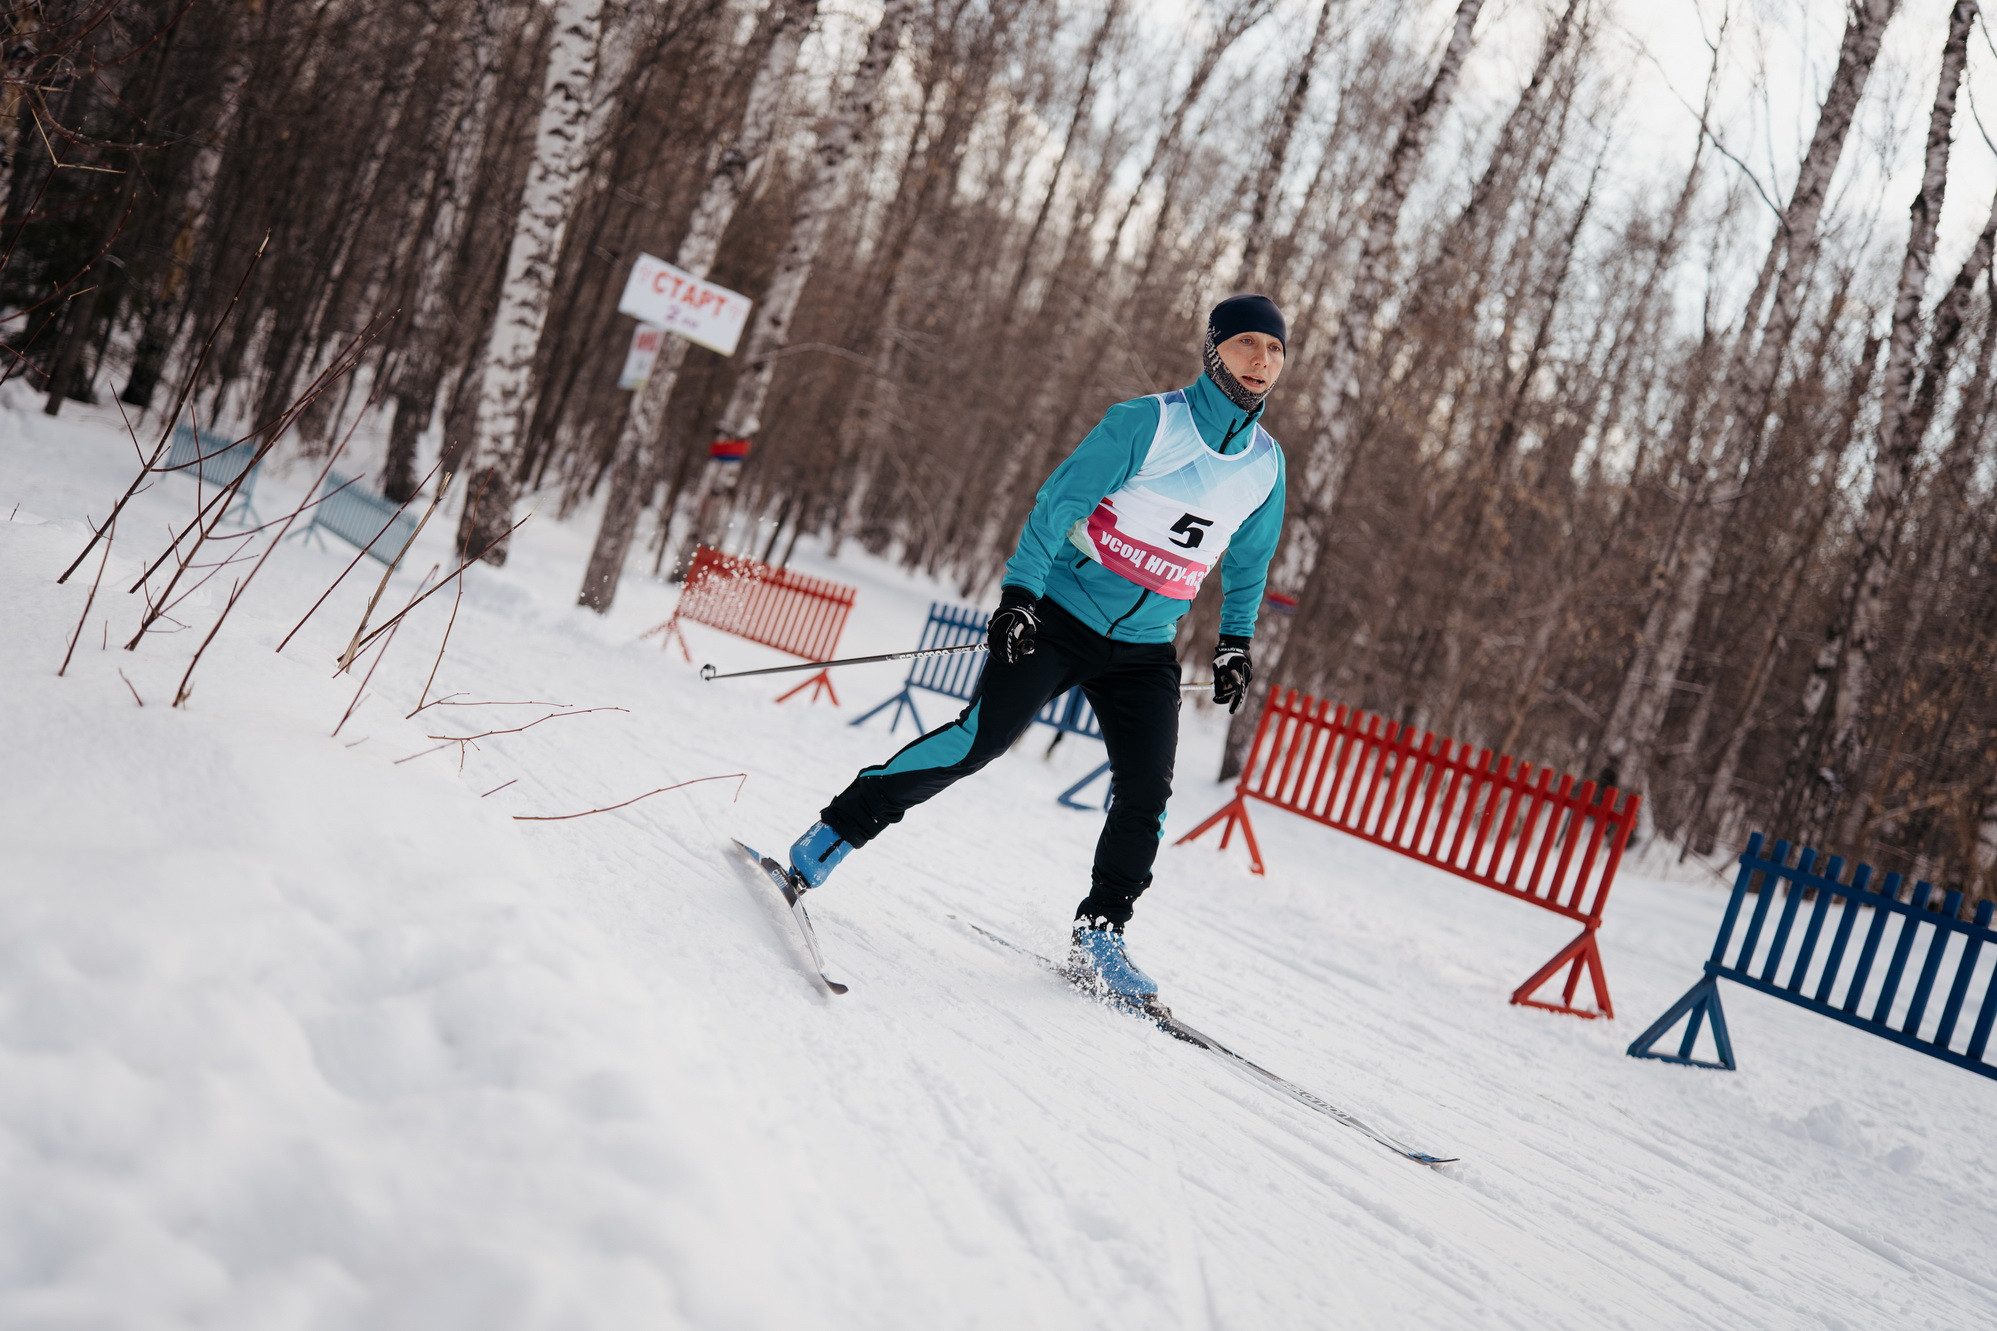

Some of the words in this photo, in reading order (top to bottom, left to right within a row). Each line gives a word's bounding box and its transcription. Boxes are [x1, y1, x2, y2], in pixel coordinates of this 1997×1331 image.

[652, 271, 729, 317] СТАРТ
[1099, 530, 1147, 568] УСОЦ
[1168, 512, 1215, 549] 5
